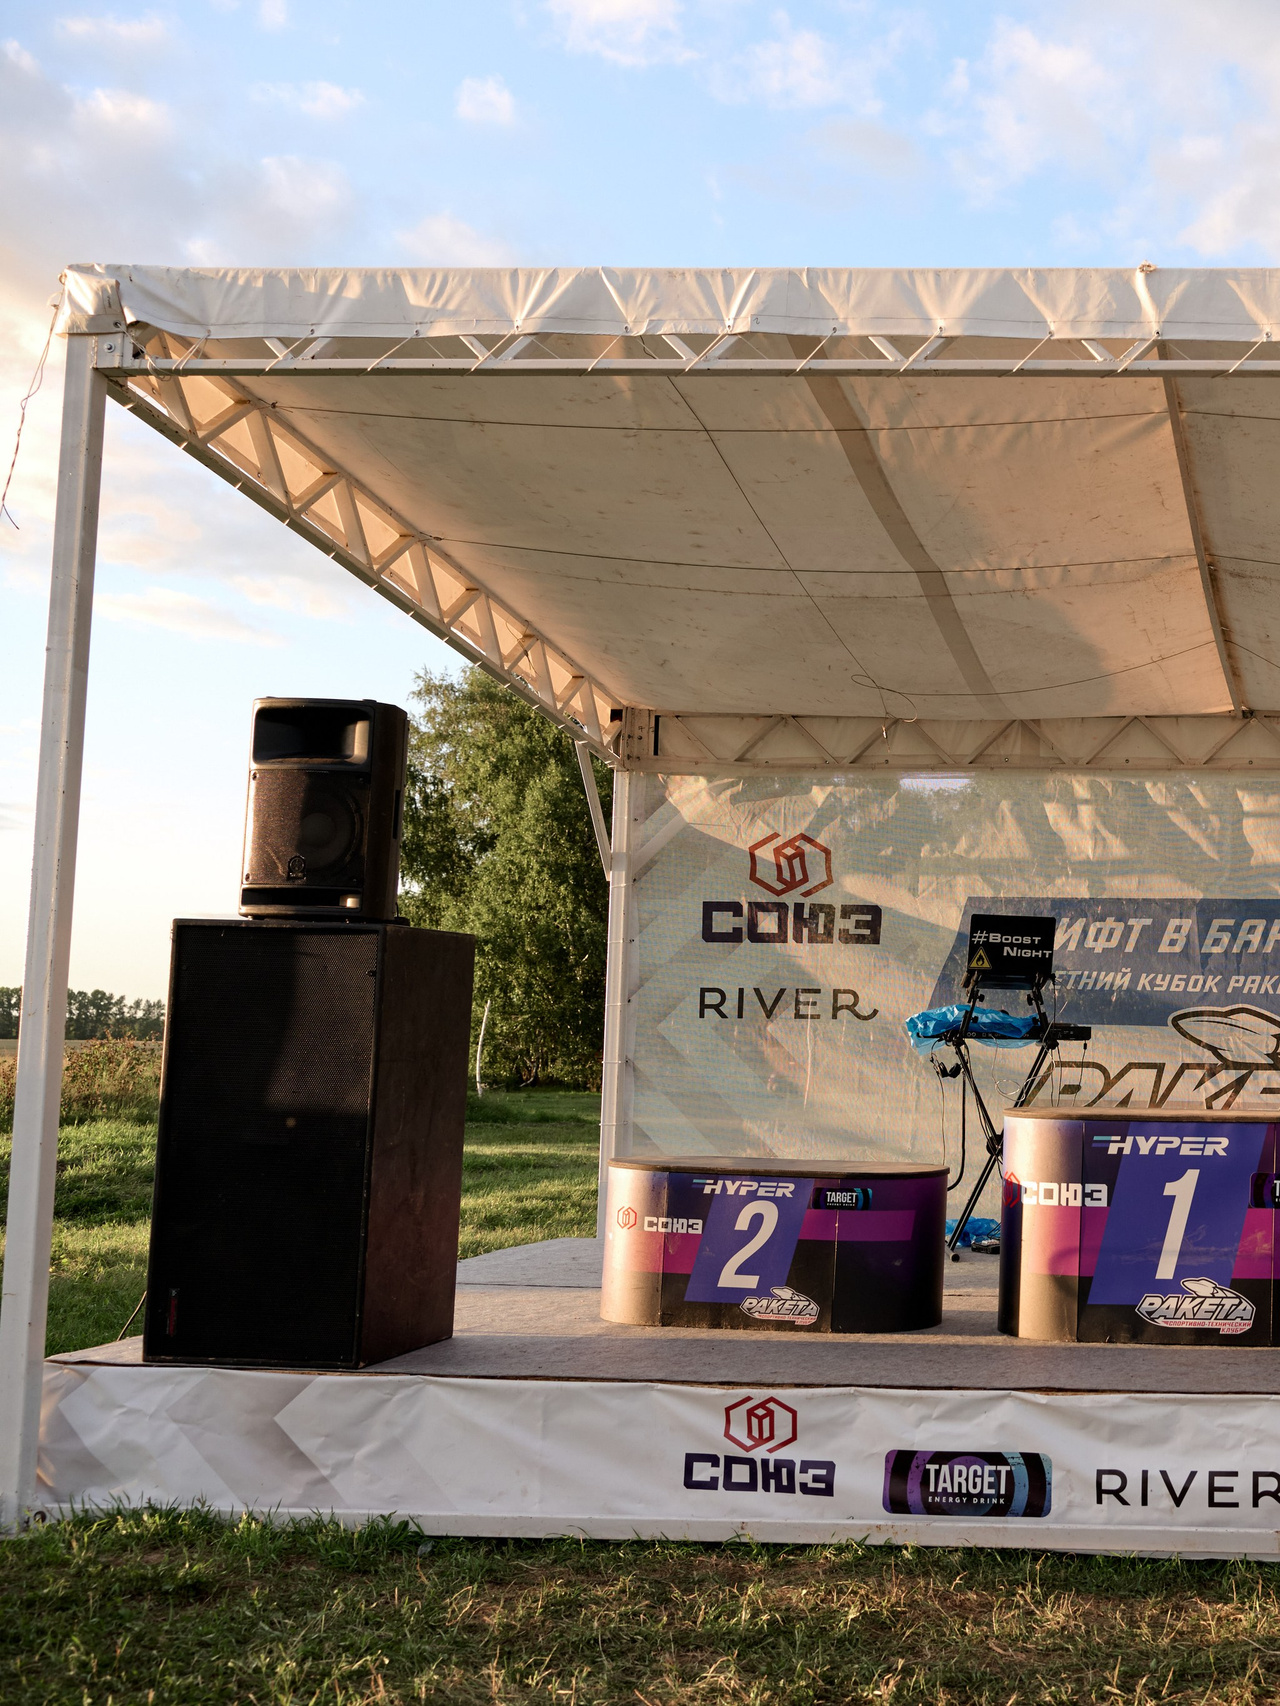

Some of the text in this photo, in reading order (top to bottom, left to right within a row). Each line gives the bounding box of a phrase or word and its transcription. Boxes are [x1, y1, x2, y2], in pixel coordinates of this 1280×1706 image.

[702, 901, 883, 945] СОЮЗ
[1053, 916, 1152, 953] ИФТ
[1158, 918, 1193, 953] В
[1049, 968, 1133, 991] ЕТНИЙ
[1136, 973, 1219, 993] КУБОК
[699, 987, 879, 1021] RIVER
[1106, 1136, 1230, 1156] HYPER
[703, 1179, 796, 1198] HYPER
[826, 1191, 857, 1203] TARGET
[1021, 1181, 1108, 1207] СОЮЗ
[644, 1216, 703, 1234] СОЮЗ
[1155, 1169, 1200, 1279] 1
[717, 1200, 779, 1288] 2
[741, 1297, 818, 1316] РАКЕТА
[1138, 1296, 1254, 1320] РАКЕТА
[683, 1452, 836, 1497] СОЮЗ
[925, 1463, 1010, 1496] TARGET
[928, 1495, 1005, 1505] ENERGY DRINK
